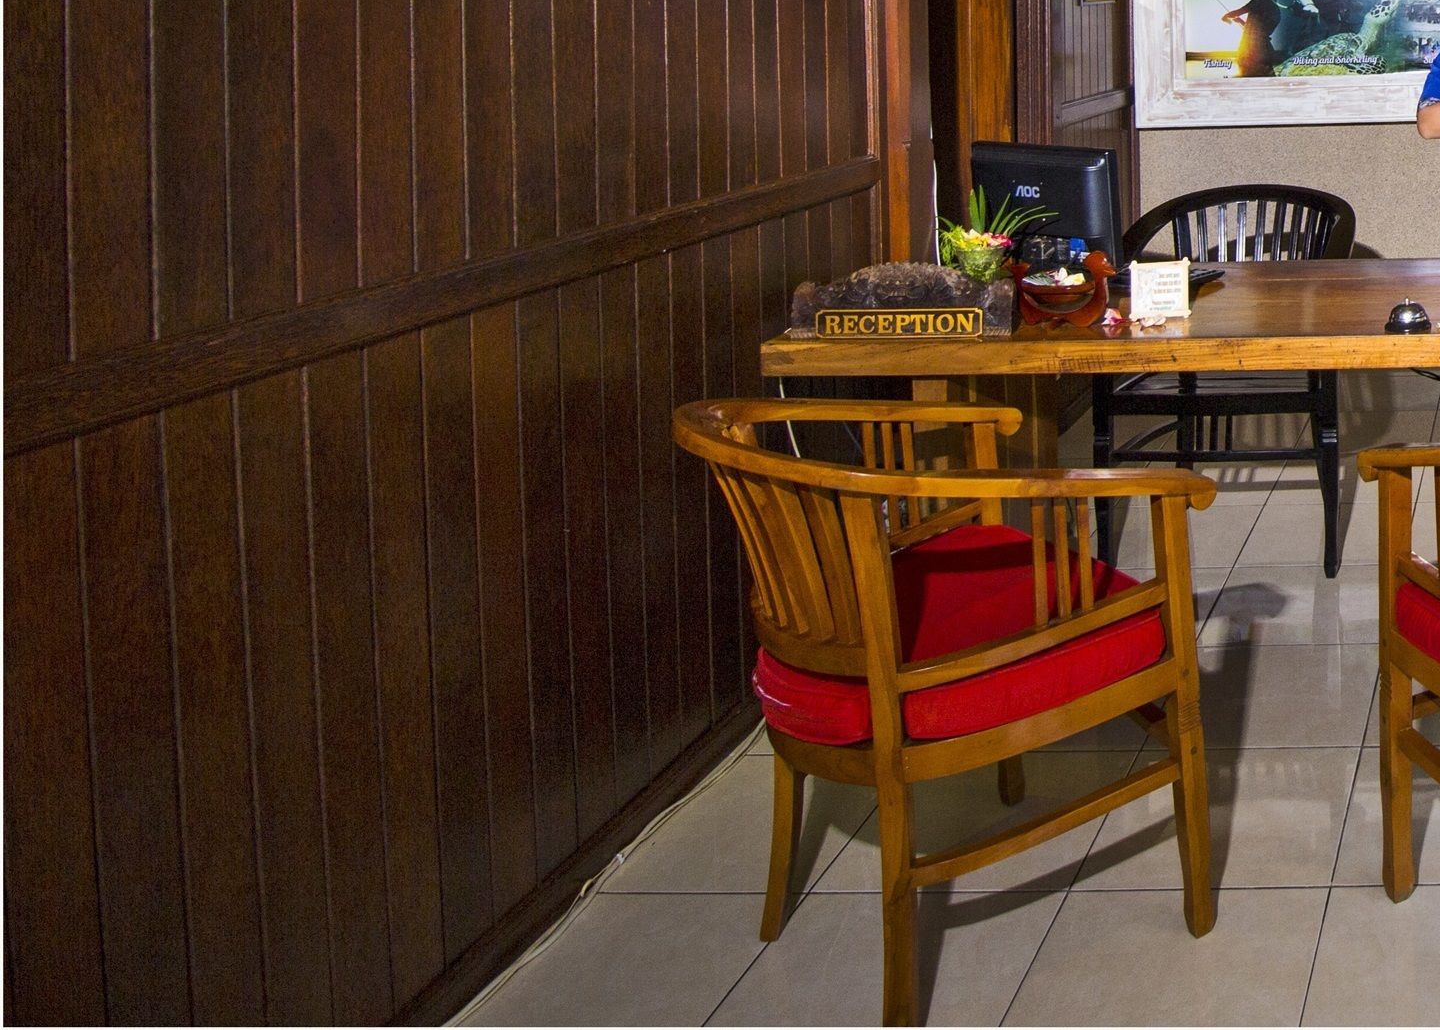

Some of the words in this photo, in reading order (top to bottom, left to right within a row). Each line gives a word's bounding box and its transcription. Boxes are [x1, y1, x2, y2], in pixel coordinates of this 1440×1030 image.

[1292, 57, 1318, 69] Diving
[1319, 55, 1335, 65] and
[1335, 54, 1378, 66] Snorkeling
[1015, 185, 1040, 198] AOC
[824, 313, 975, 334] RECEPTION
